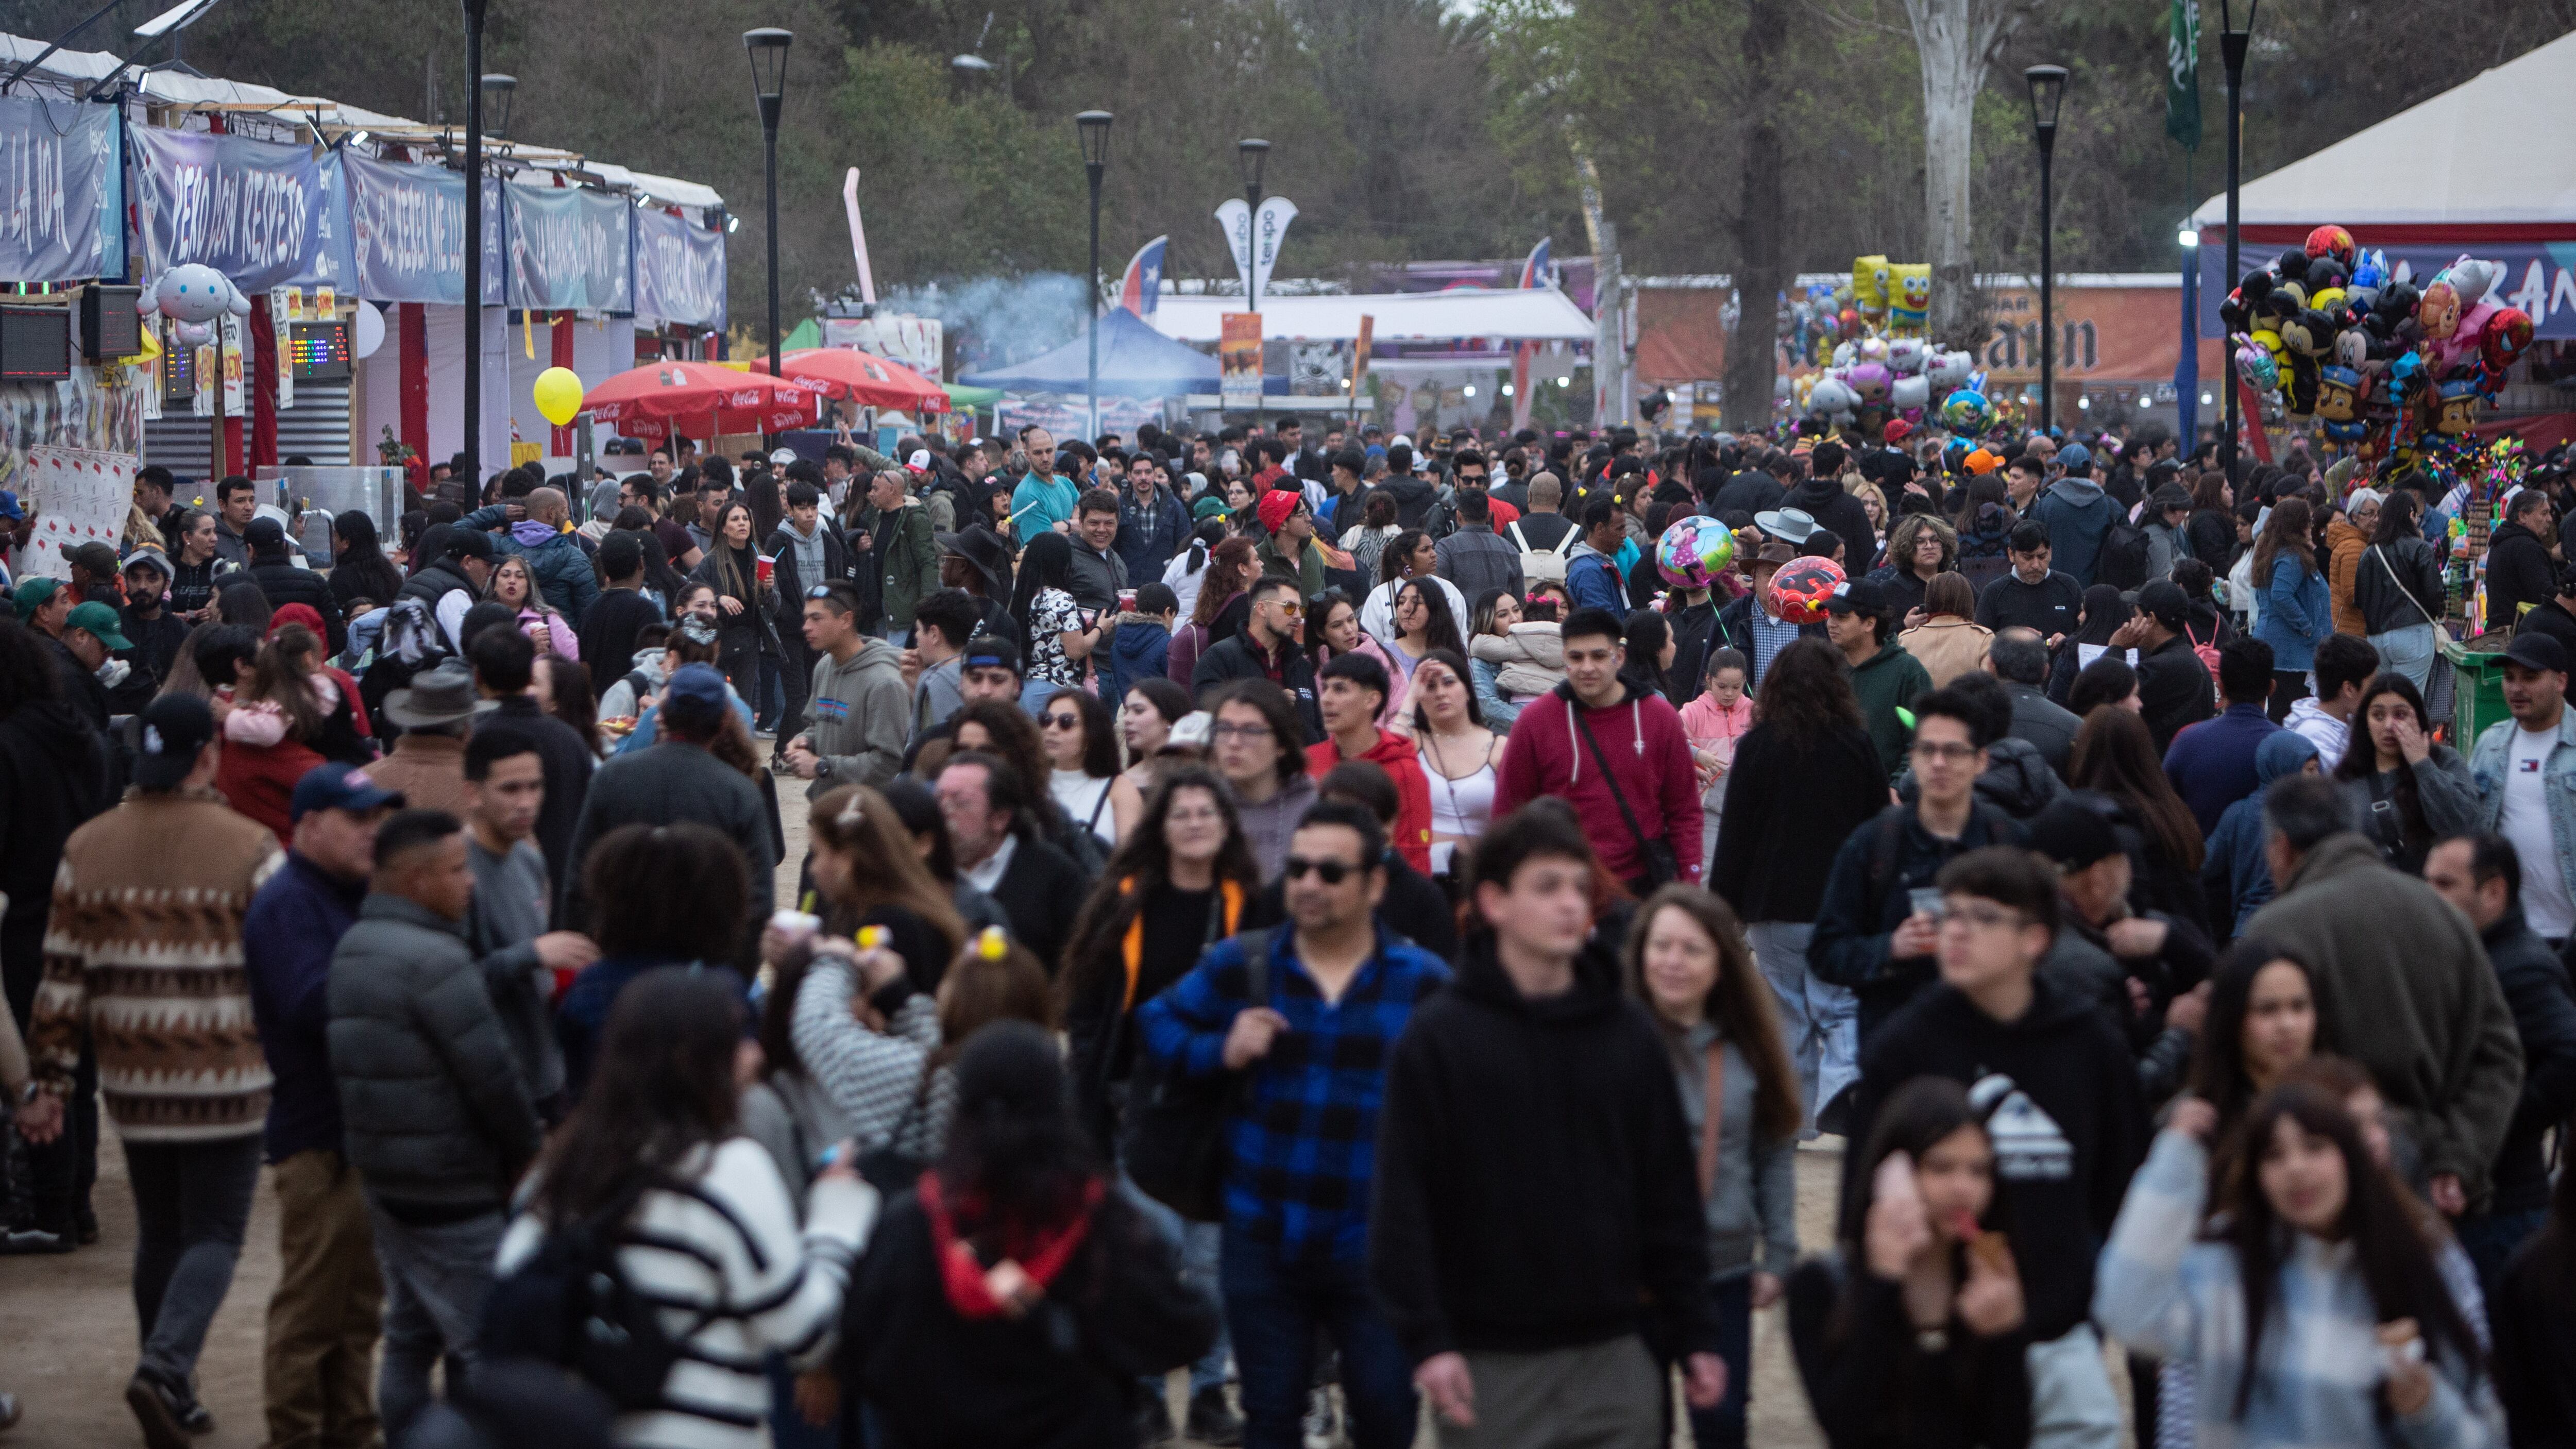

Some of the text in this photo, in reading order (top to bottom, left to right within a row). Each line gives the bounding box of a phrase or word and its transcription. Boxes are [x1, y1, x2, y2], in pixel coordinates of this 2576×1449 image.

[168, 161, 210, 265] PERO
[206, 162, 239, 264] CON
[242, 166, 306, 268] RESPETO
[732, 389, 759, 407] Coca-Cola
[775, 389, 800, 405] ca-Cola
